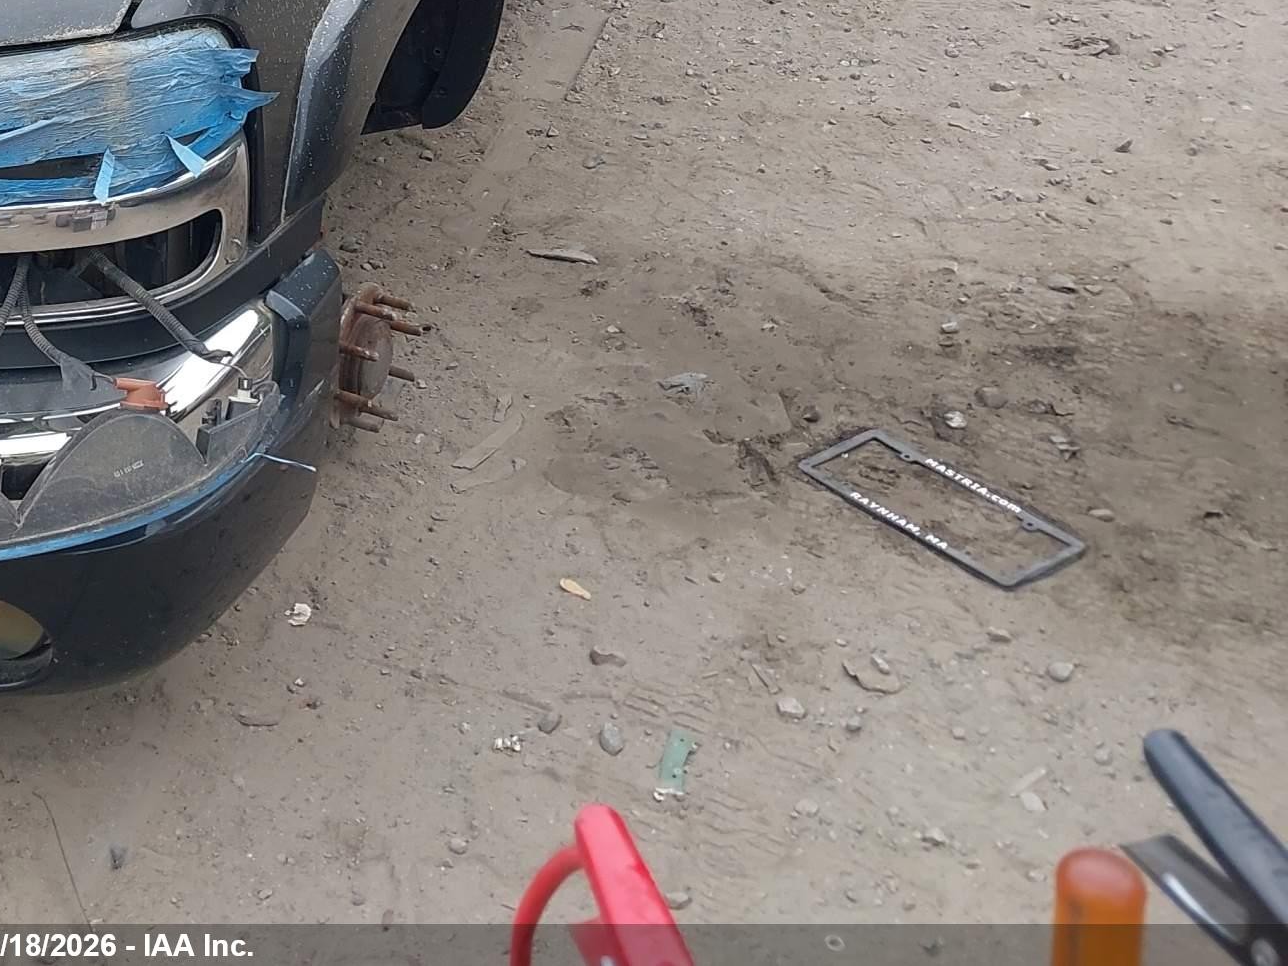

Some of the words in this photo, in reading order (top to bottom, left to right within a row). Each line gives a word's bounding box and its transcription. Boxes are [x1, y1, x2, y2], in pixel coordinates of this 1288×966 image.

[924, 458, 1022, 513] MASTRIA.com
[850, 492, 921, 536] RAYNHAM,
[925, 534, 948, 549] MA
